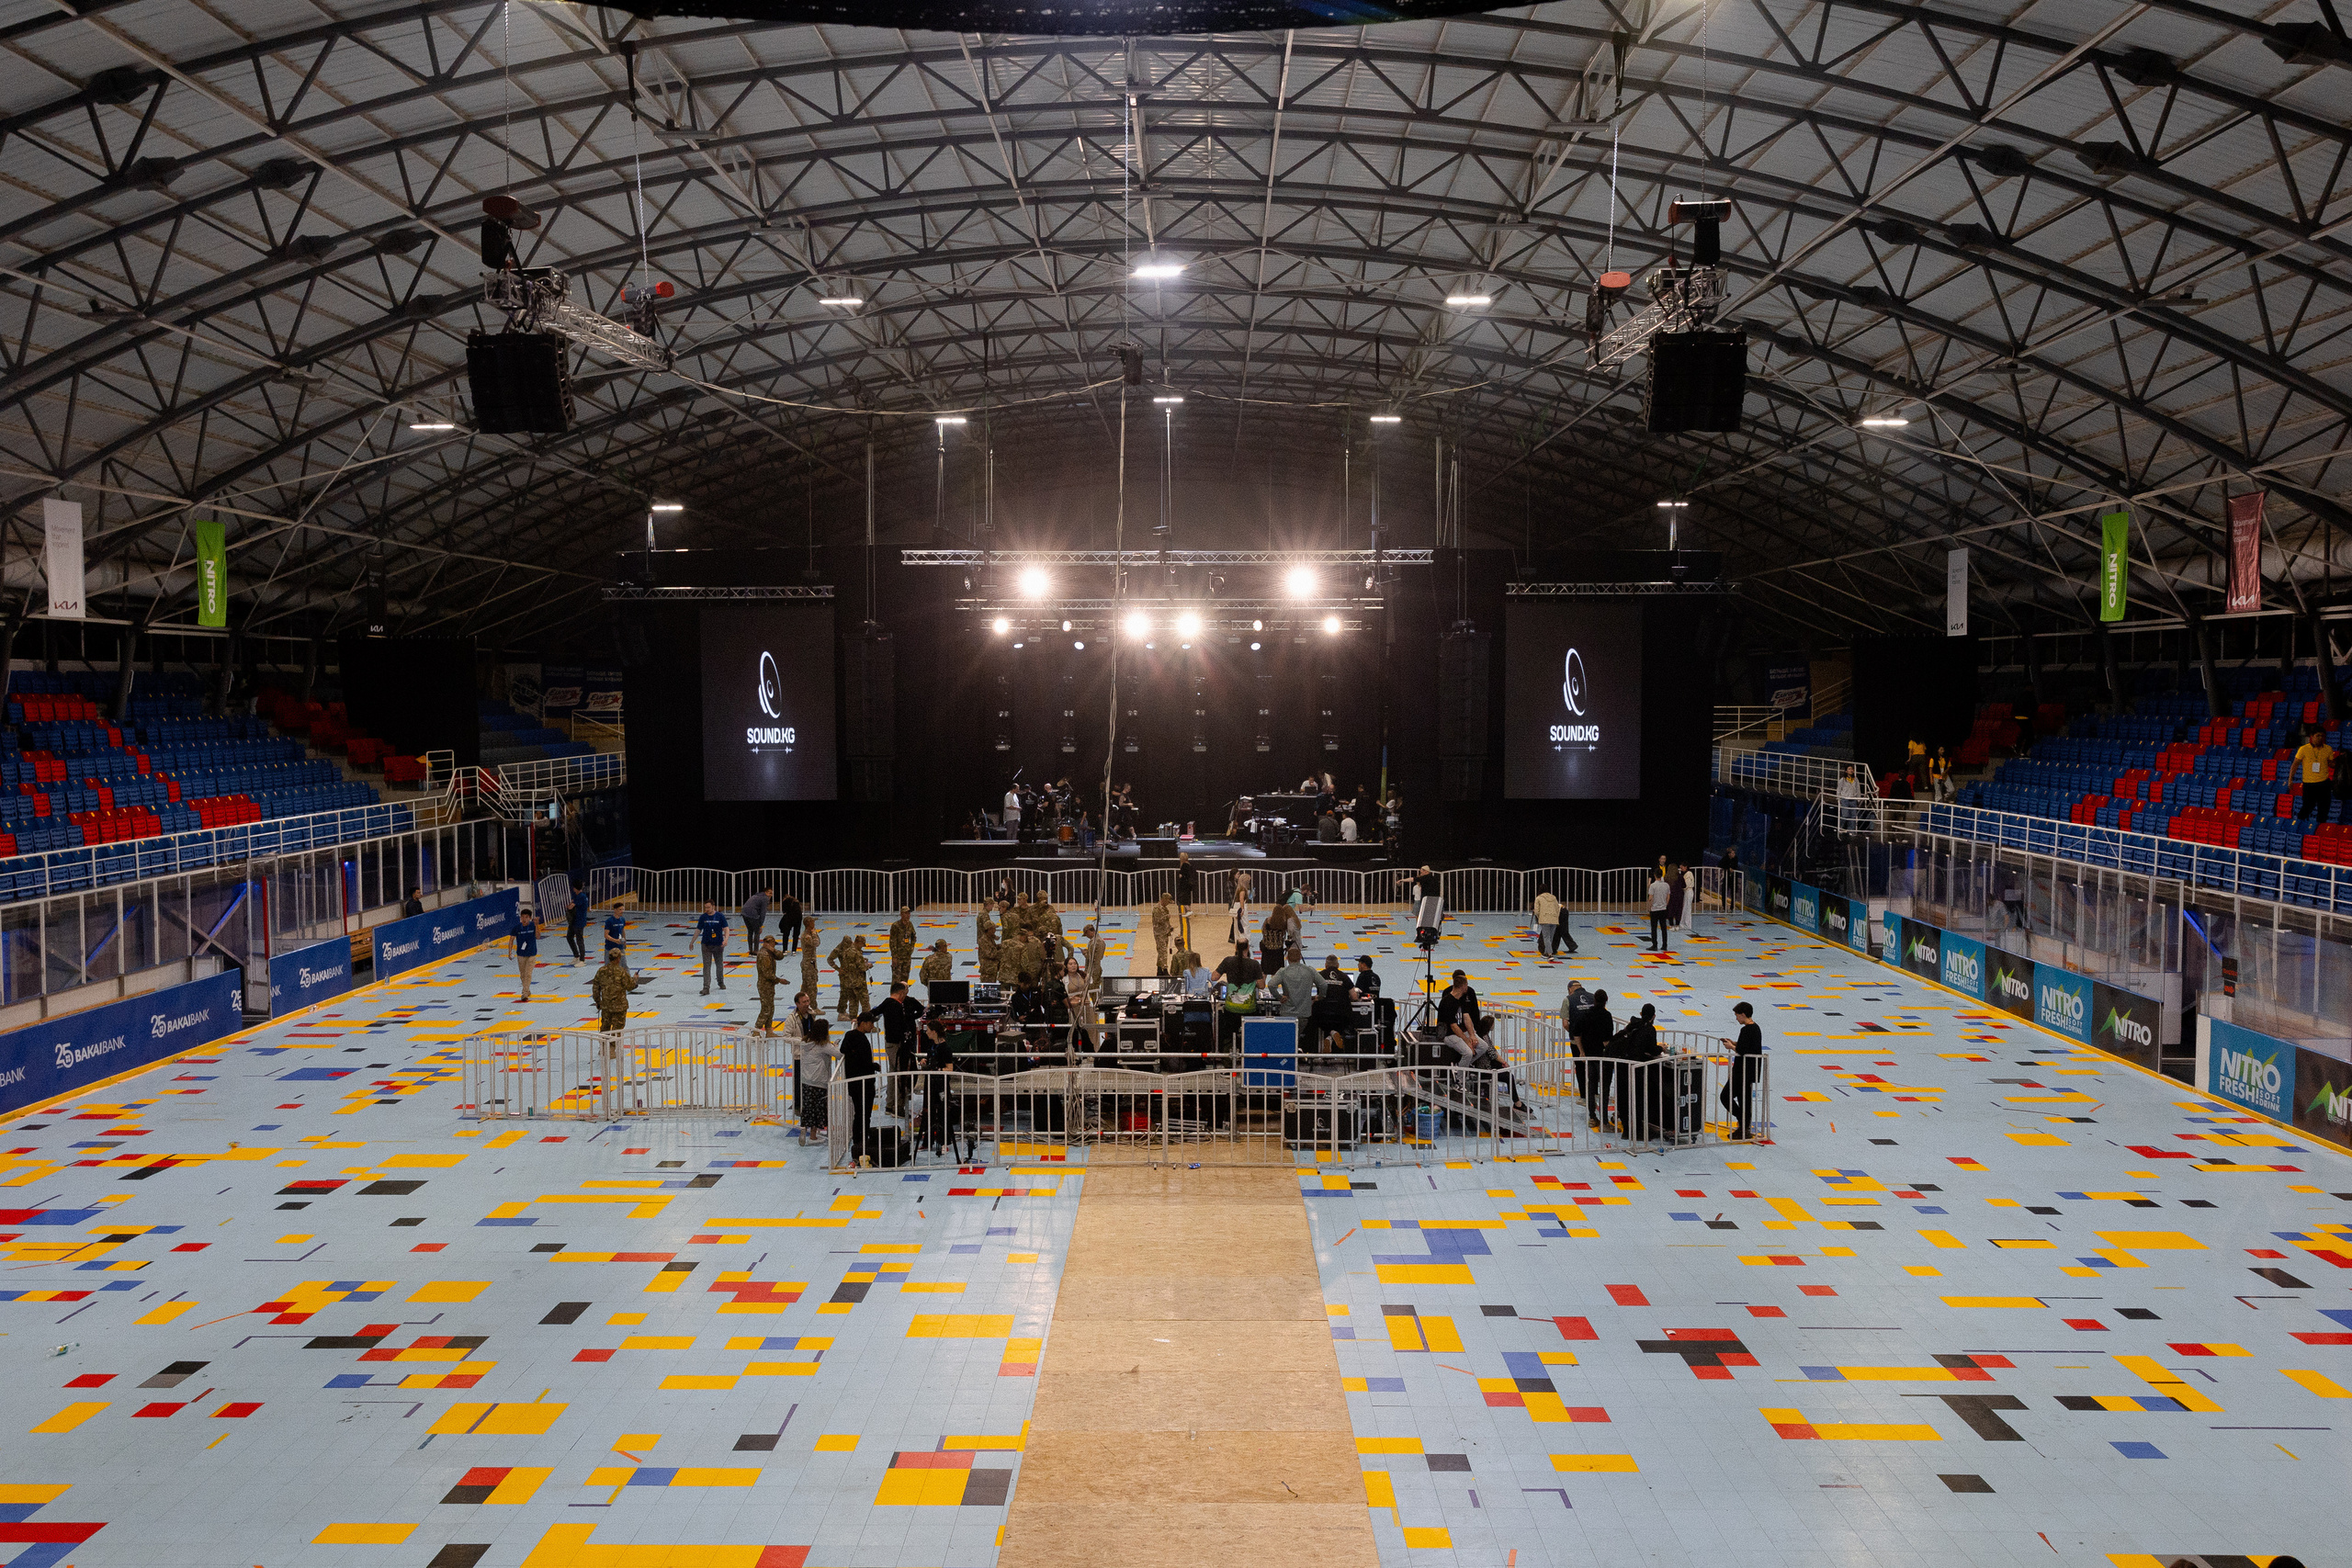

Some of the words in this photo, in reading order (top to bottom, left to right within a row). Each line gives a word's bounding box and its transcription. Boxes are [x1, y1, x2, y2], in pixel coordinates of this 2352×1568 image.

[207, 559, 216, 614] NITRO
[2109, 553, 2118, 608] NITRO
[747, 728, 796, 744] SOUND.KG
[1550, 725, 1599, 741] SOUND.KG
[1773, 892, 1789, 908] NITRO
[1794, 897, 1815, 919] NITRO
[1828, 911, 1847, 931] NITRO
[433, 927, 442, 944] 25
[382, 942, 392, 961] 25
[1914, 942, 1937, 964] NITRO
[1946, 950, 1978, 980] NITRO
[300, 967, 311, 987] 25
[1945, 970, 1967, 987] FRESH!
[2001, 975, 2029, 1000] NITRO
[2041, 985, 2084, 1020] NITRO
[151, 1014, 167, 1038] 25
[167, 1009, 210, 1033] BAKAIBANK
[2041, 1008, 2068, 1030] FRESH!
[2114, 1015, 2152, 1046] NITRO
[55, 1043, 74, 1068] 25
[74, 1035, 127, 1063] BAKAIBANK
[2220, 1047, 2281, 1094] NITRO
[2219, 1075, 2259, 1105] FRESH!
[2260, 1092, 2280, 1104] SOFT
[2260, 1100, 2280, 1112] DRINK
